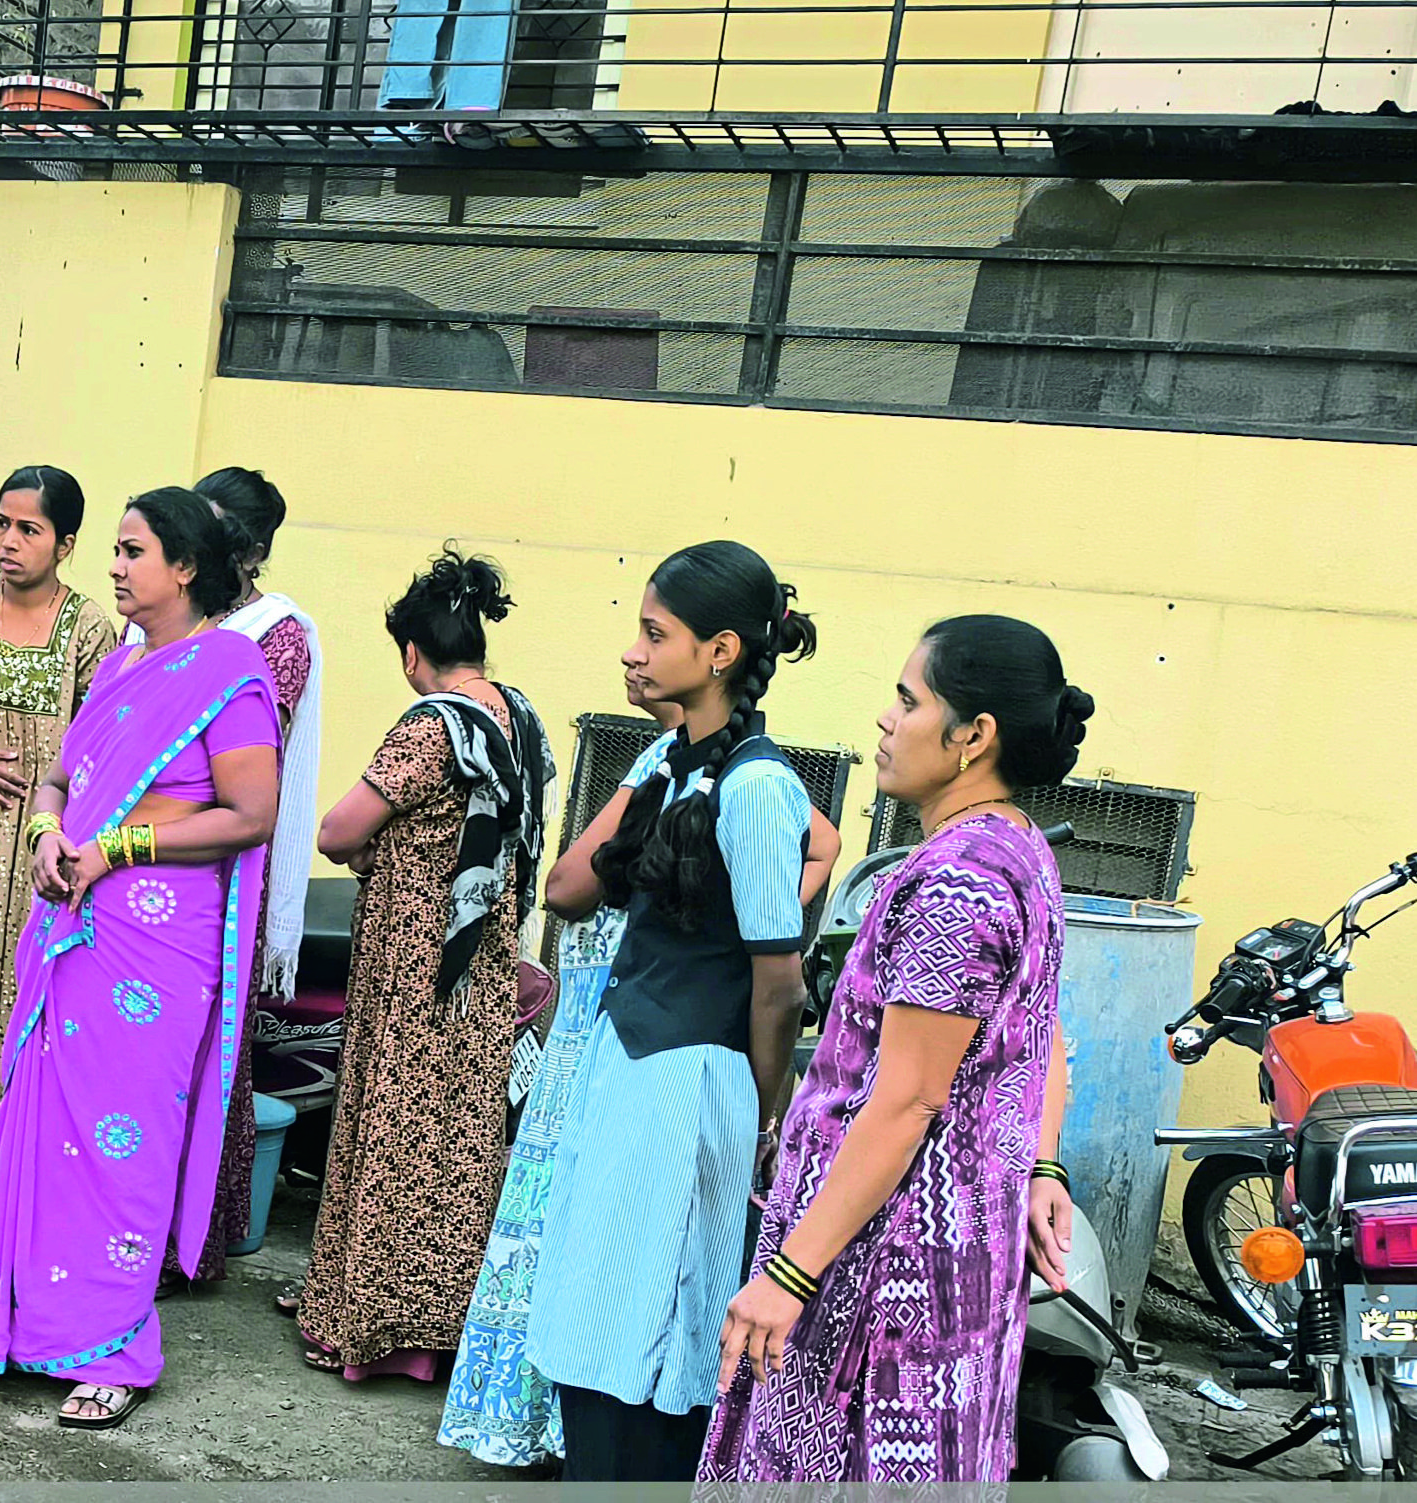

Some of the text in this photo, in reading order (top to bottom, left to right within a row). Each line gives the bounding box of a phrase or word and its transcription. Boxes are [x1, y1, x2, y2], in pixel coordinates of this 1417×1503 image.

[263, 1018, 341, 1037] Pleasure
[1369, 1162, 1417, 1184] YAM
[1360, 1322, 1417, 1341] K3
